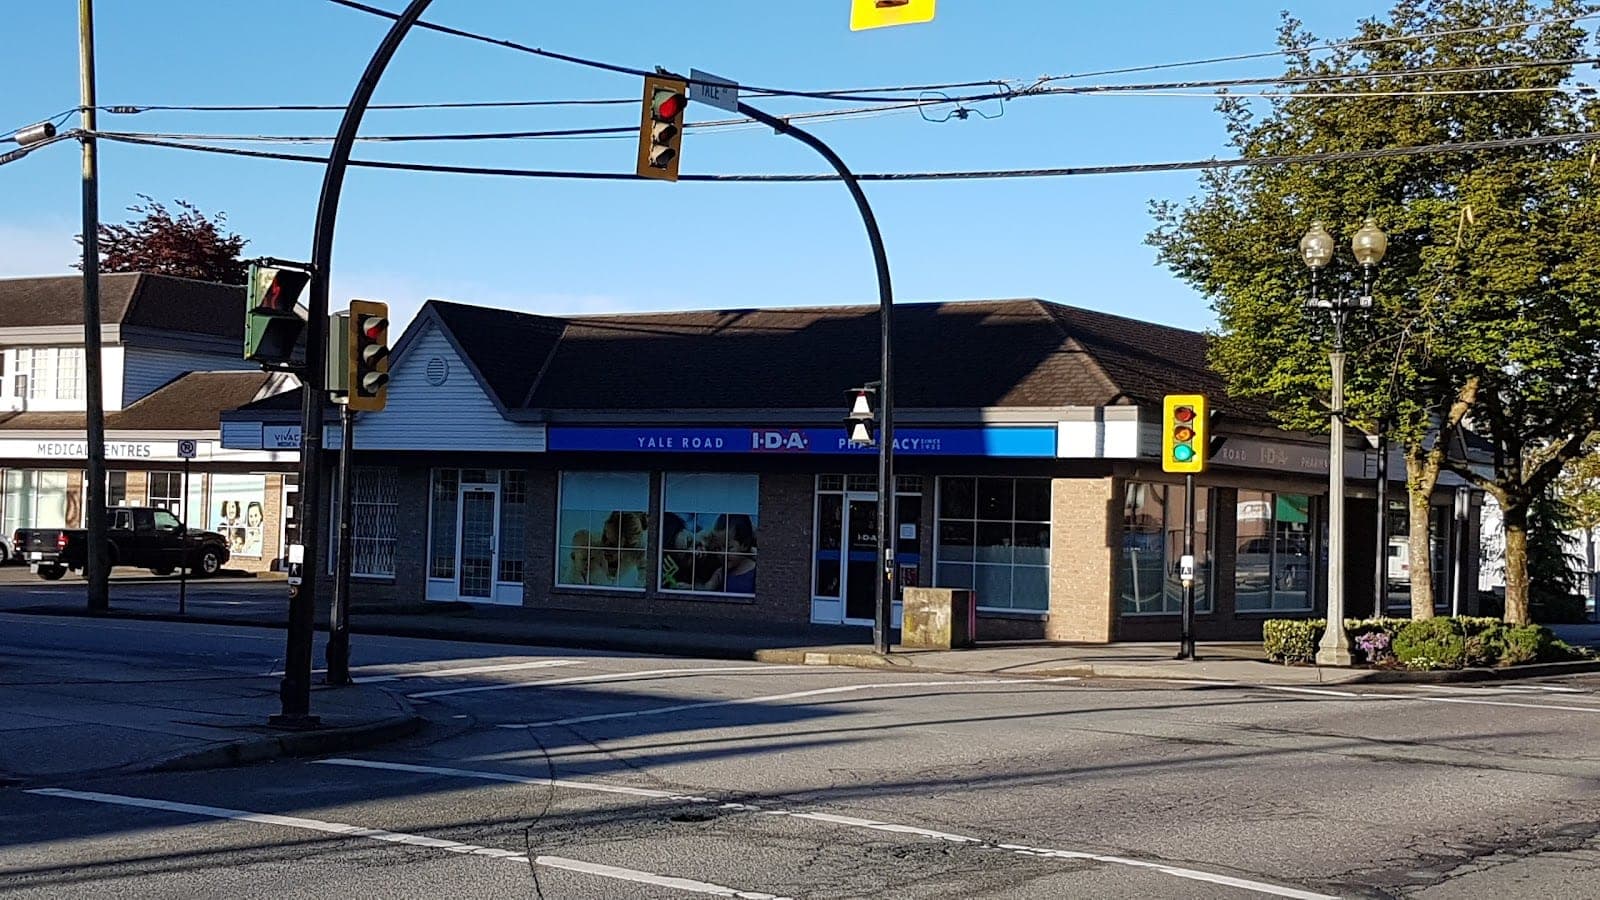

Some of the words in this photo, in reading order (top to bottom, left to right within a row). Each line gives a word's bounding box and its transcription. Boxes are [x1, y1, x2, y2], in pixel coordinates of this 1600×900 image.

[37, 443, 88, 456] MEDICAL
[103, 444, 151, 458] ENTRES
[638, 437, 673, 448] YALE
[682, 437, 724, 449] ROAD
[838, 438, 919, 450] PHACY
